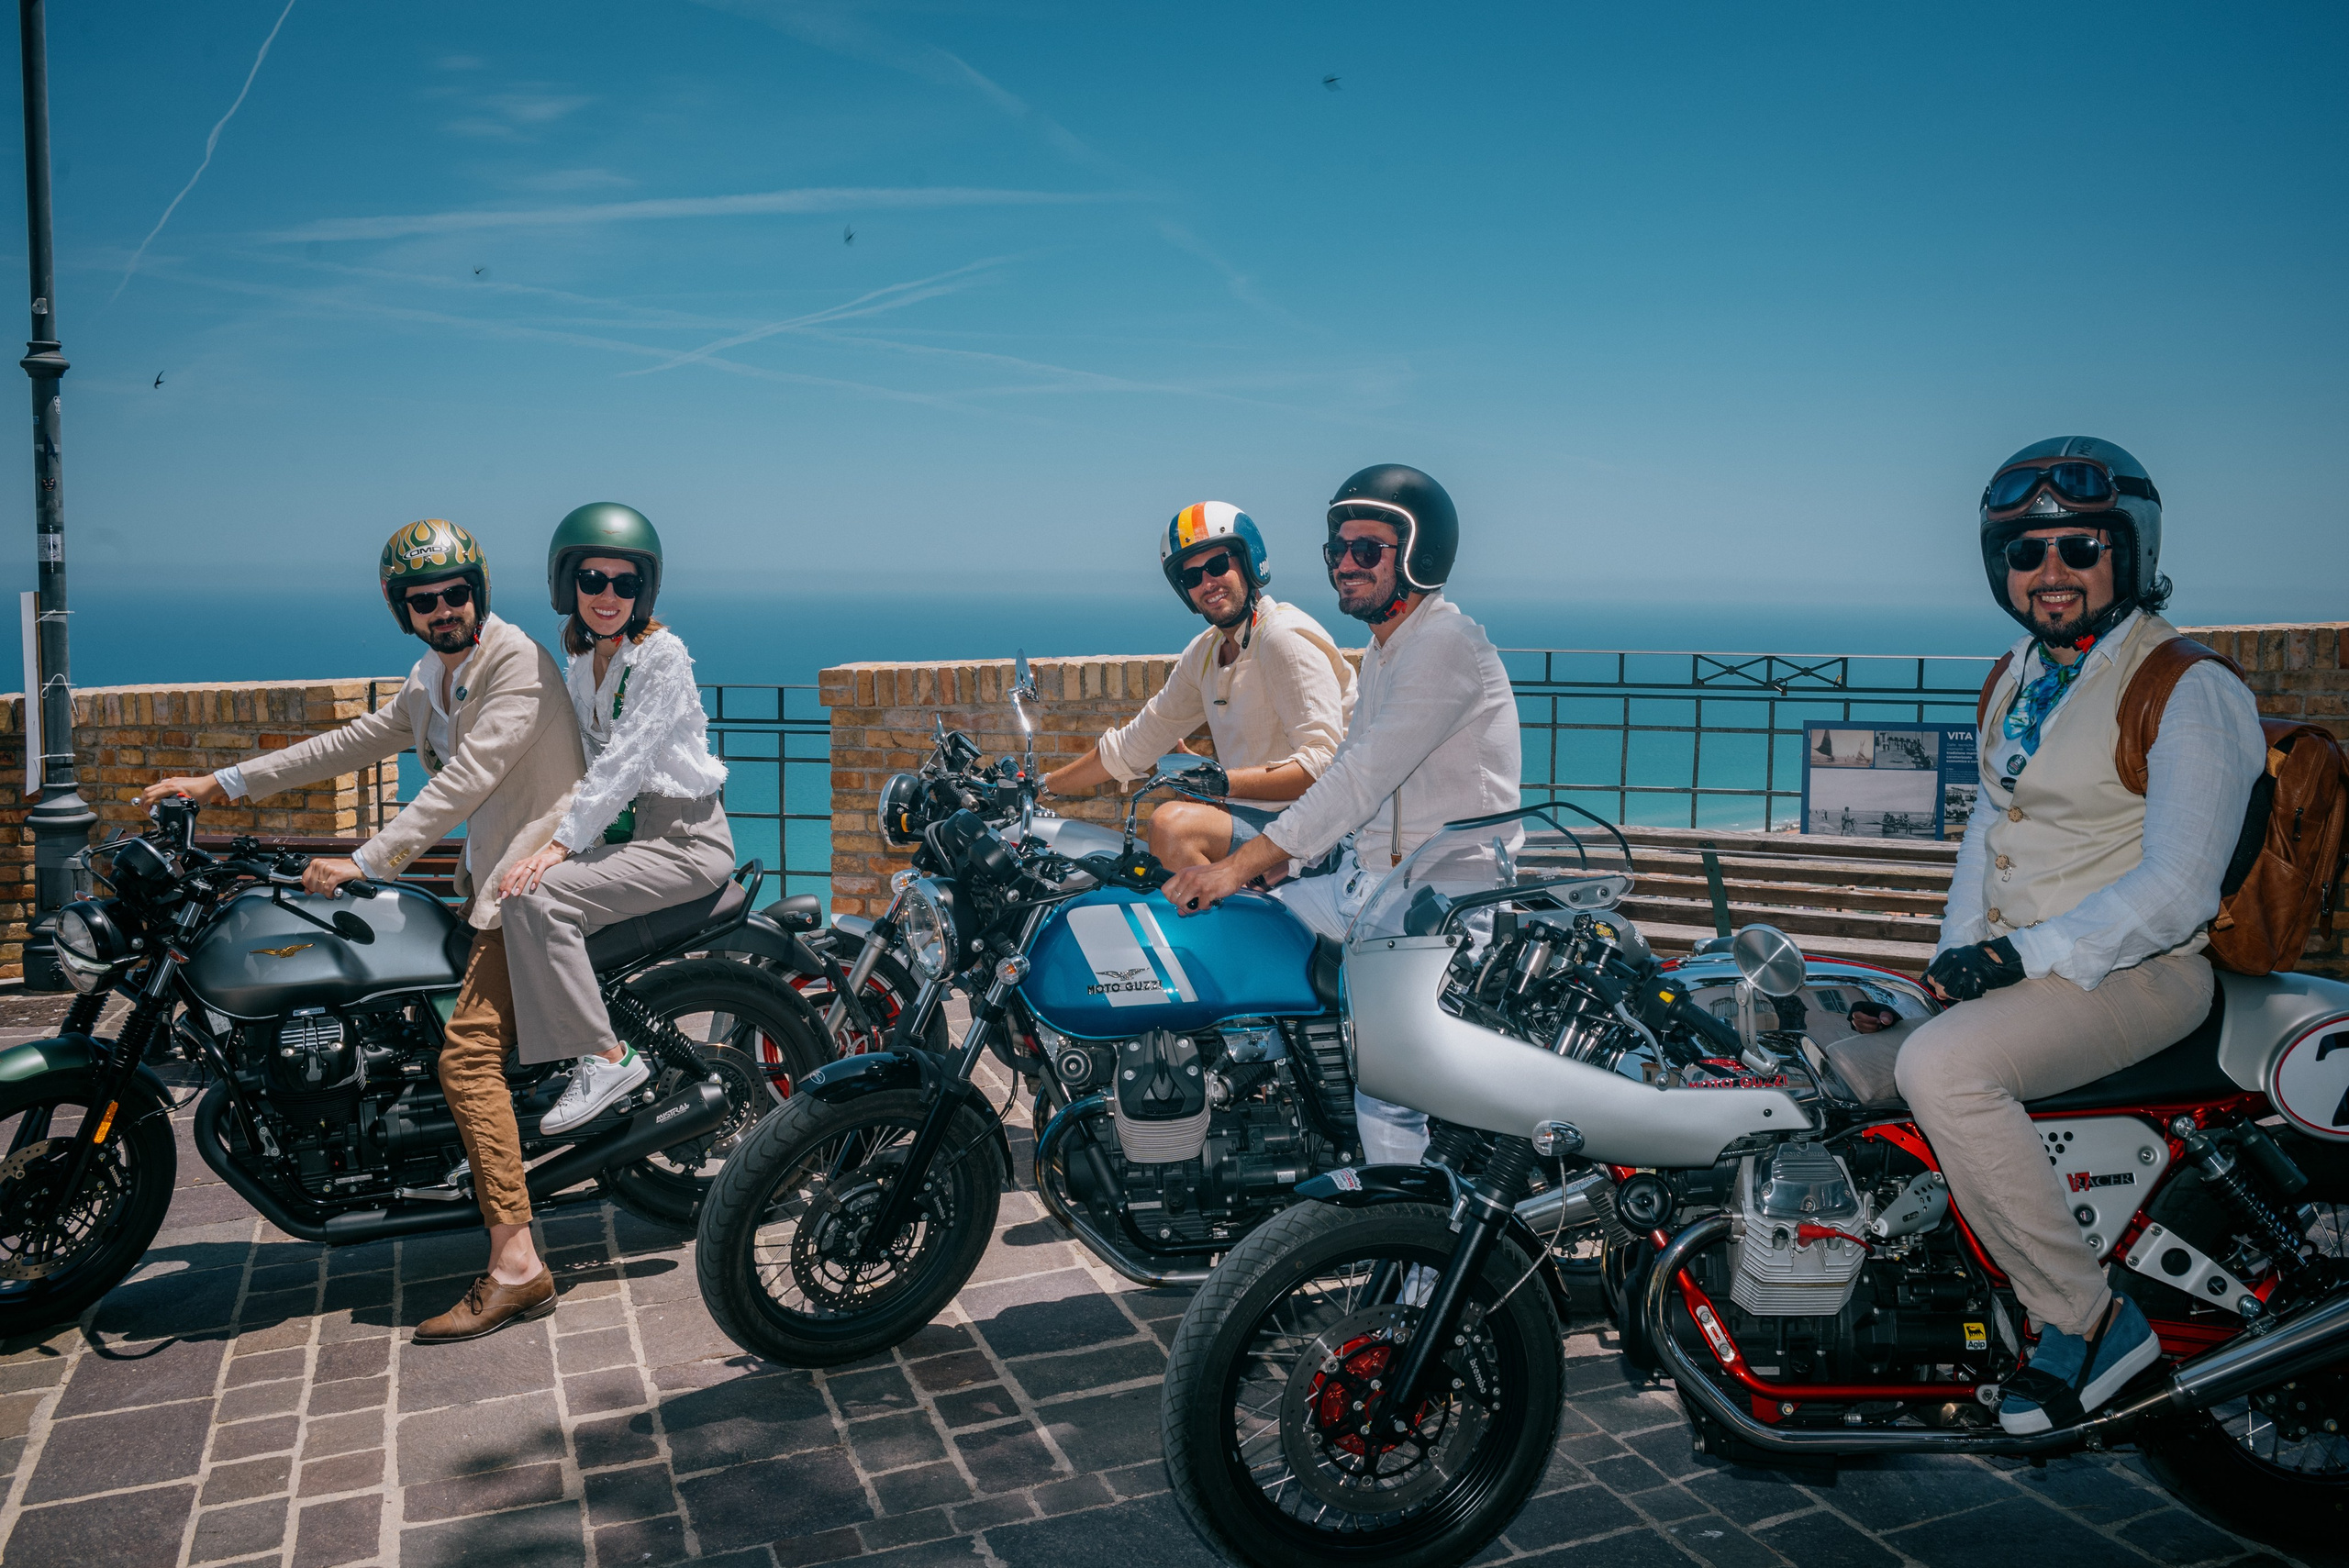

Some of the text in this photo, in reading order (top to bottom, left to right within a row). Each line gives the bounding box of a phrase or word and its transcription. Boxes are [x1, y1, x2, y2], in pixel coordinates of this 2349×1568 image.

[1947, 731, 1973, 740] VITA
[1087, 980, 1163, 995] MOTO GUZZI
[1688, 1073, 1789, 1089] MOTO GUZZI
[655, 1102, 690, 1124] MISTRAL
[108, 1164, 122, 1187] brembo
[2066, 1172, 2133, 1192] V7 RACER
[933, 1195, 946, 1219] brembo
[1967, 1340, 1986, 1350] Agip
[1469, 1358, 1486, 1394] brembo
